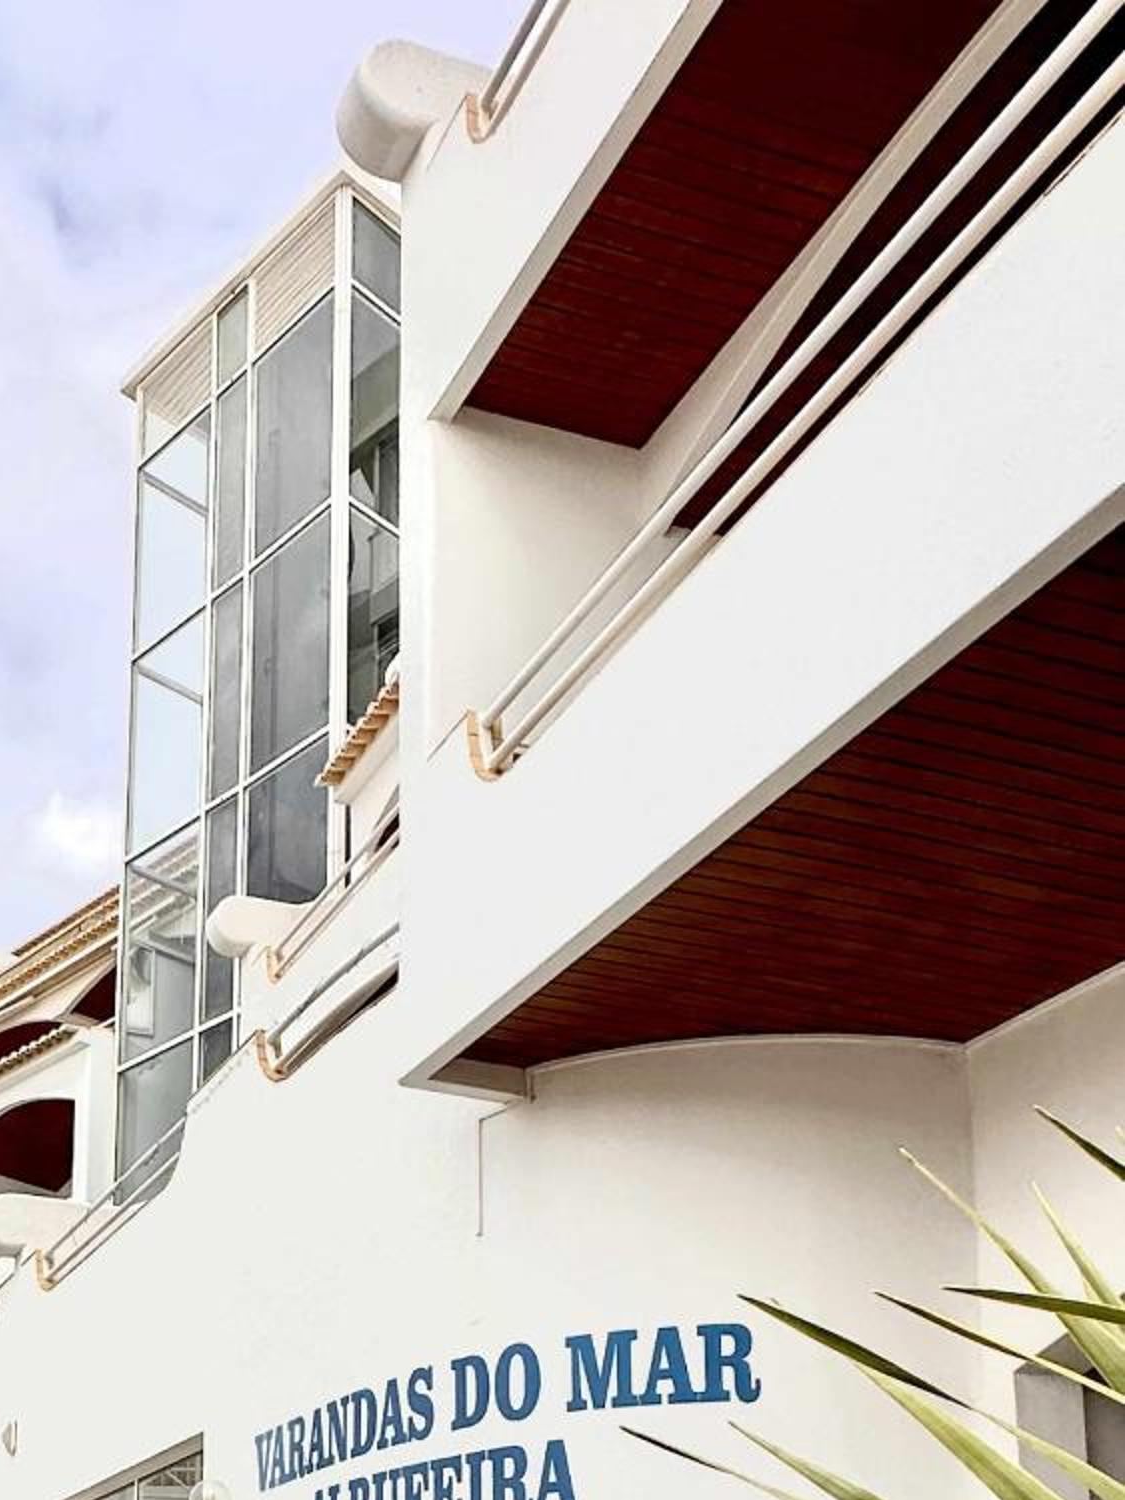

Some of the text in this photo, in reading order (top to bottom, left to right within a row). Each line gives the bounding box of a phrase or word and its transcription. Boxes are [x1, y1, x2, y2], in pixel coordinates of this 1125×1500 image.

[255, 1323, 762, 1492] VARANDAS DO MAR
